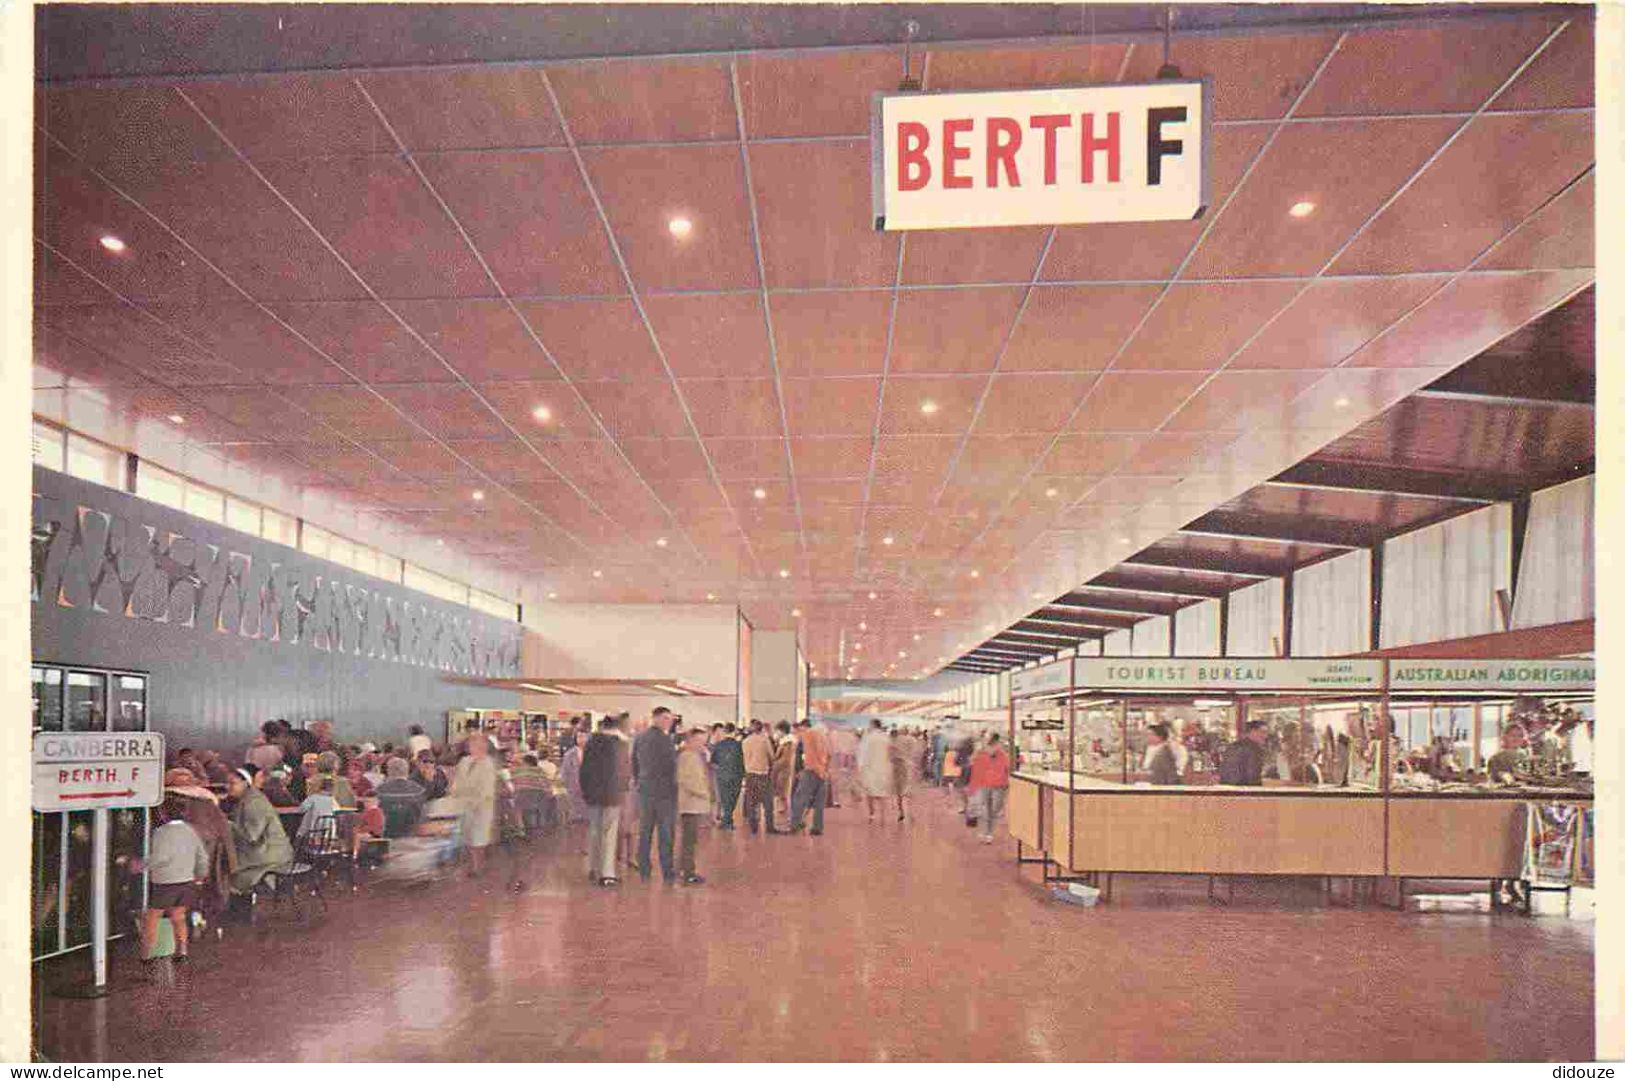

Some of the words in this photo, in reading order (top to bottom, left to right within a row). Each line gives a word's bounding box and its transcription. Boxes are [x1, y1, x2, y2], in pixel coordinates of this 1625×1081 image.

[897, 111, 1120, 191] BERTH
[1147, 106, 1188, 185] F
[1107, 666, 1187, 680] TOURIST
[1199, 667, 1266, 680] BUREAU
[1395, 668, 1488, 681] AUSTRALIAN
[43, 738, 154, 757] CANBERRA
[59, 767, 117, 783] BERTH
[131, 766, 140, 781] F
